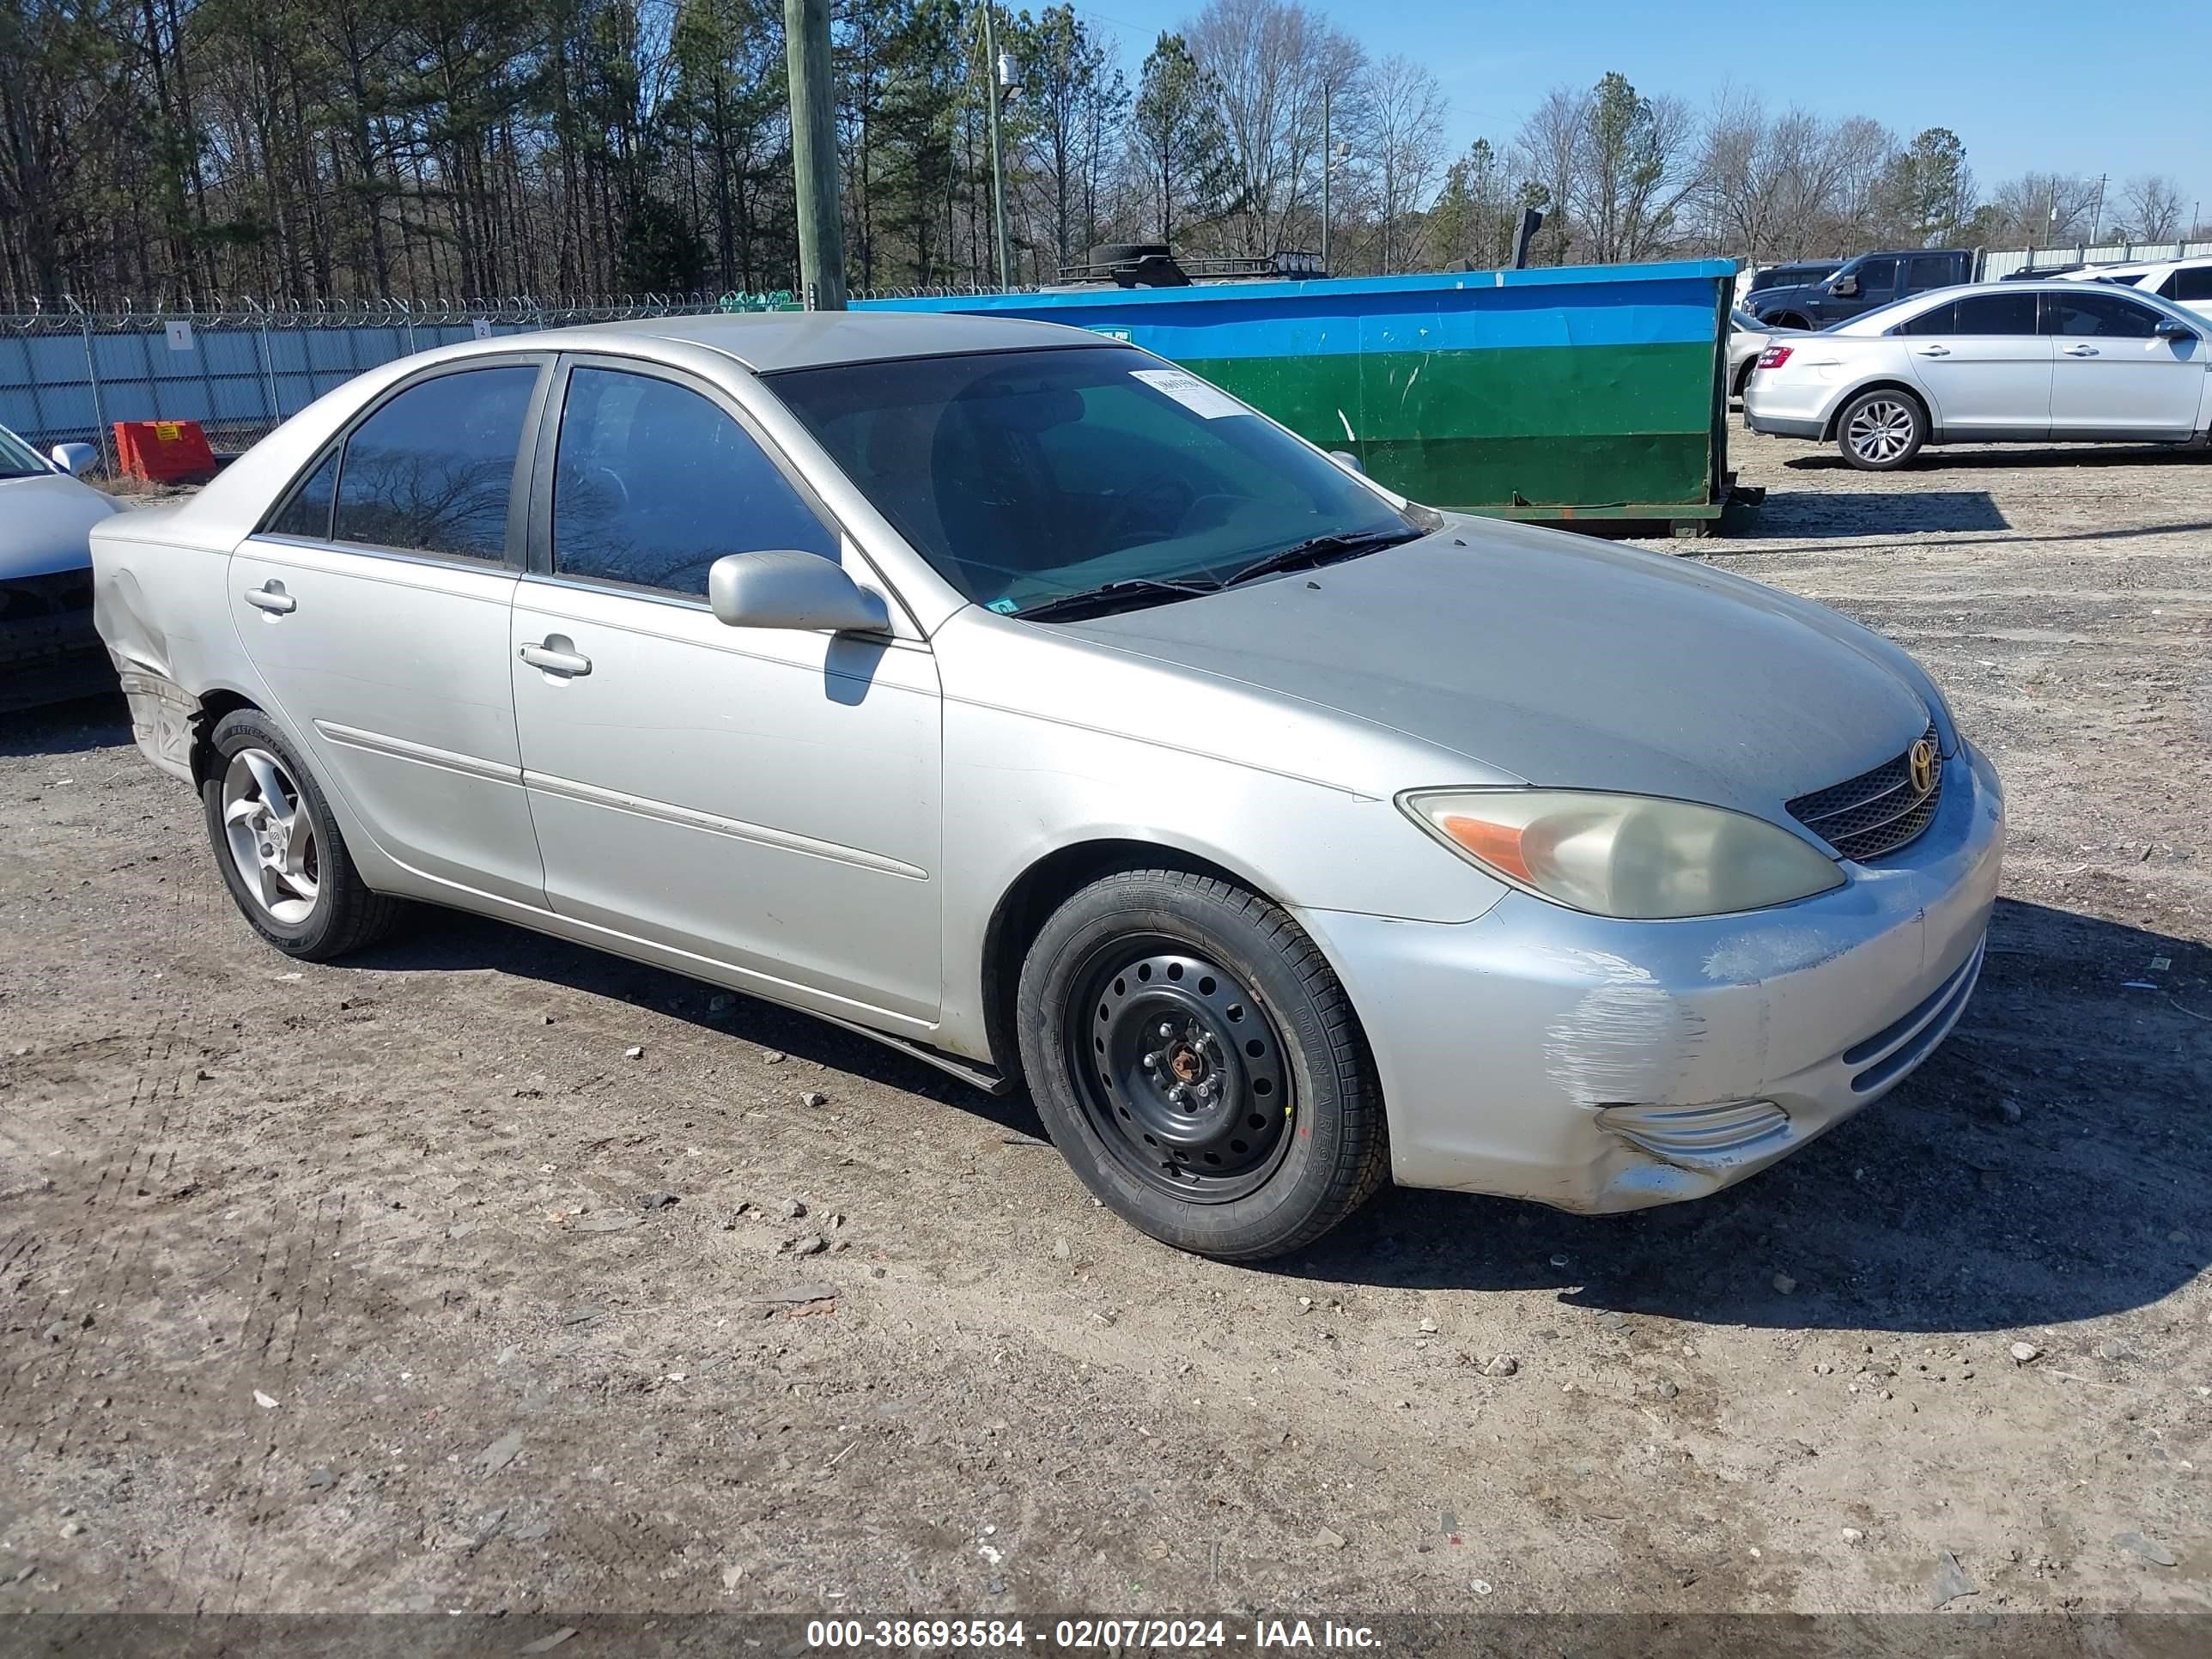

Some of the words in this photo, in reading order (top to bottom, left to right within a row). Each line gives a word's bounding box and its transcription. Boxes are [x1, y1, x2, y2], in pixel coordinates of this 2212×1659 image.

[176, 330, 182, 340] 1
[479, 326, 486, 336] 2
[1295, 1006, 1333, 1107] POTENZA
[1310, 1113, 1334, 1176] RE92
